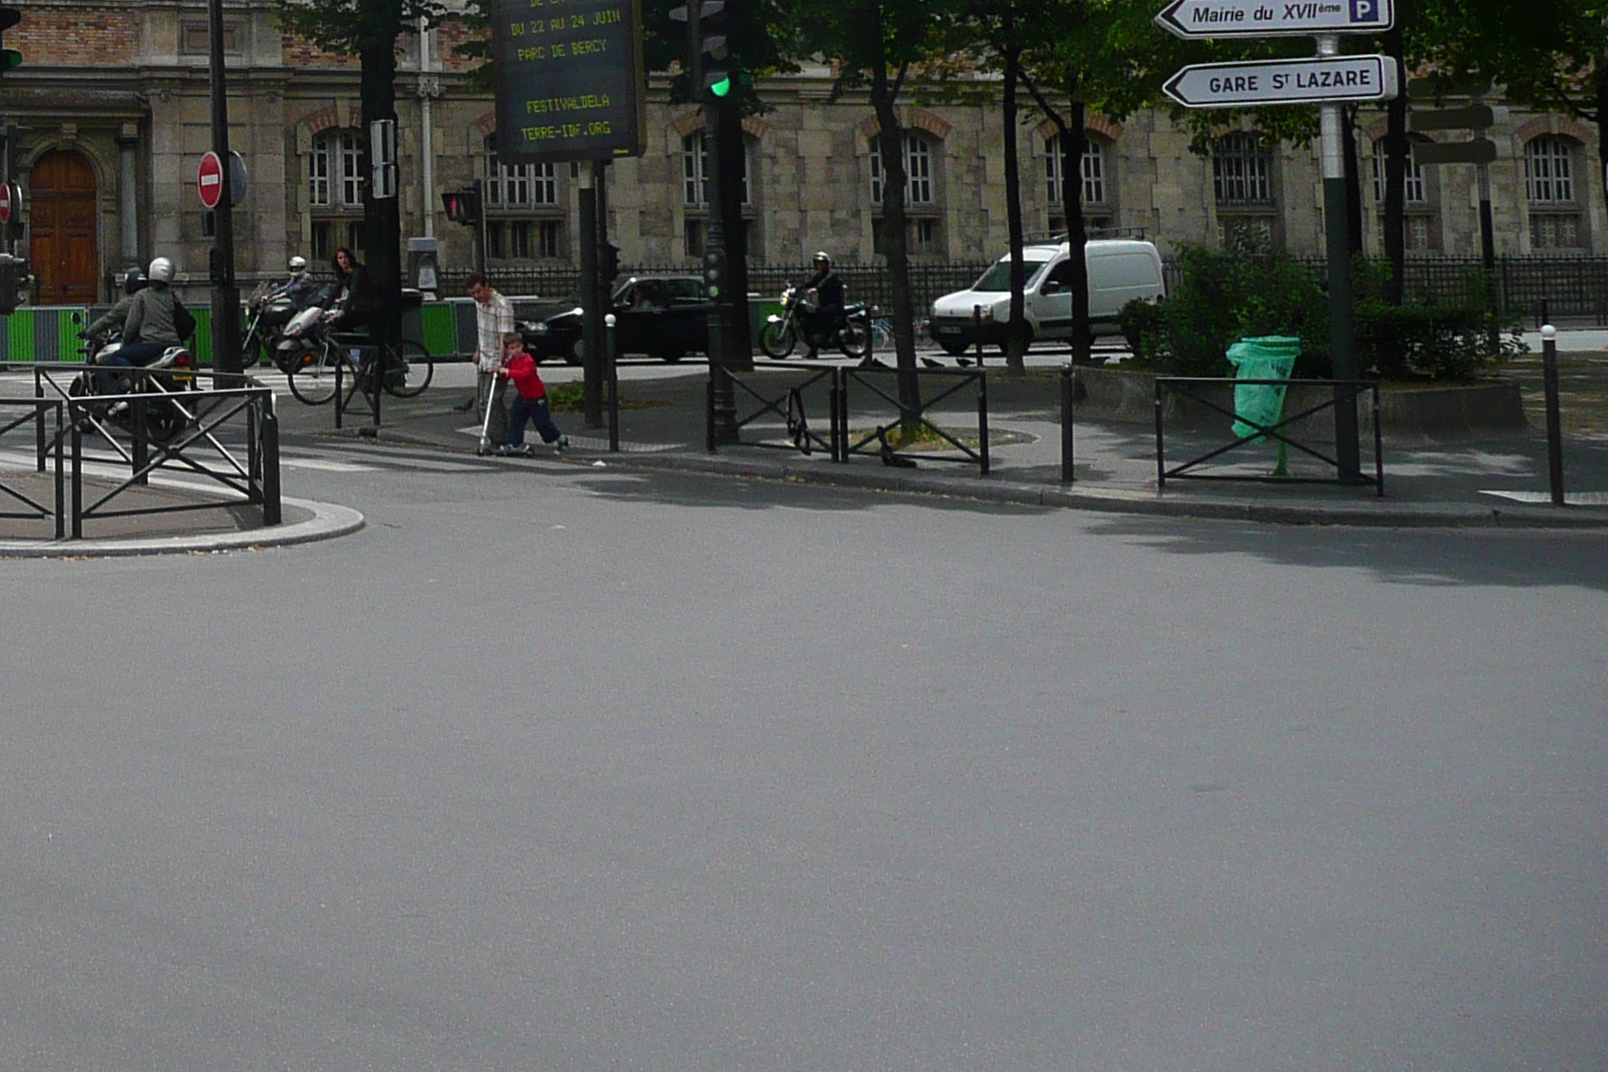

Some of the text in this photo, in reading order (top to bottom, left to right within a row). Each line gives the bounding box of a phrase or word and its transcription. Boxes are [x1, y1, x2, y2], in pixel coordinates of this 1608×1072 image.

[511, 9, 621, 37] DU 22 AU 24 JUIN
[1192, 6, 1245, 23] Mairie
[1253, 5, 1274, 21] du
[1356, 0, 1372, 19] P
[517, 38, 607, 62] PARC DE BERCY
[1209, 75, 1259, 94] GARE
[1295, 69, 1371, 89] LAZARE
[526, 93, 610, 114] FESTIVALDELA
